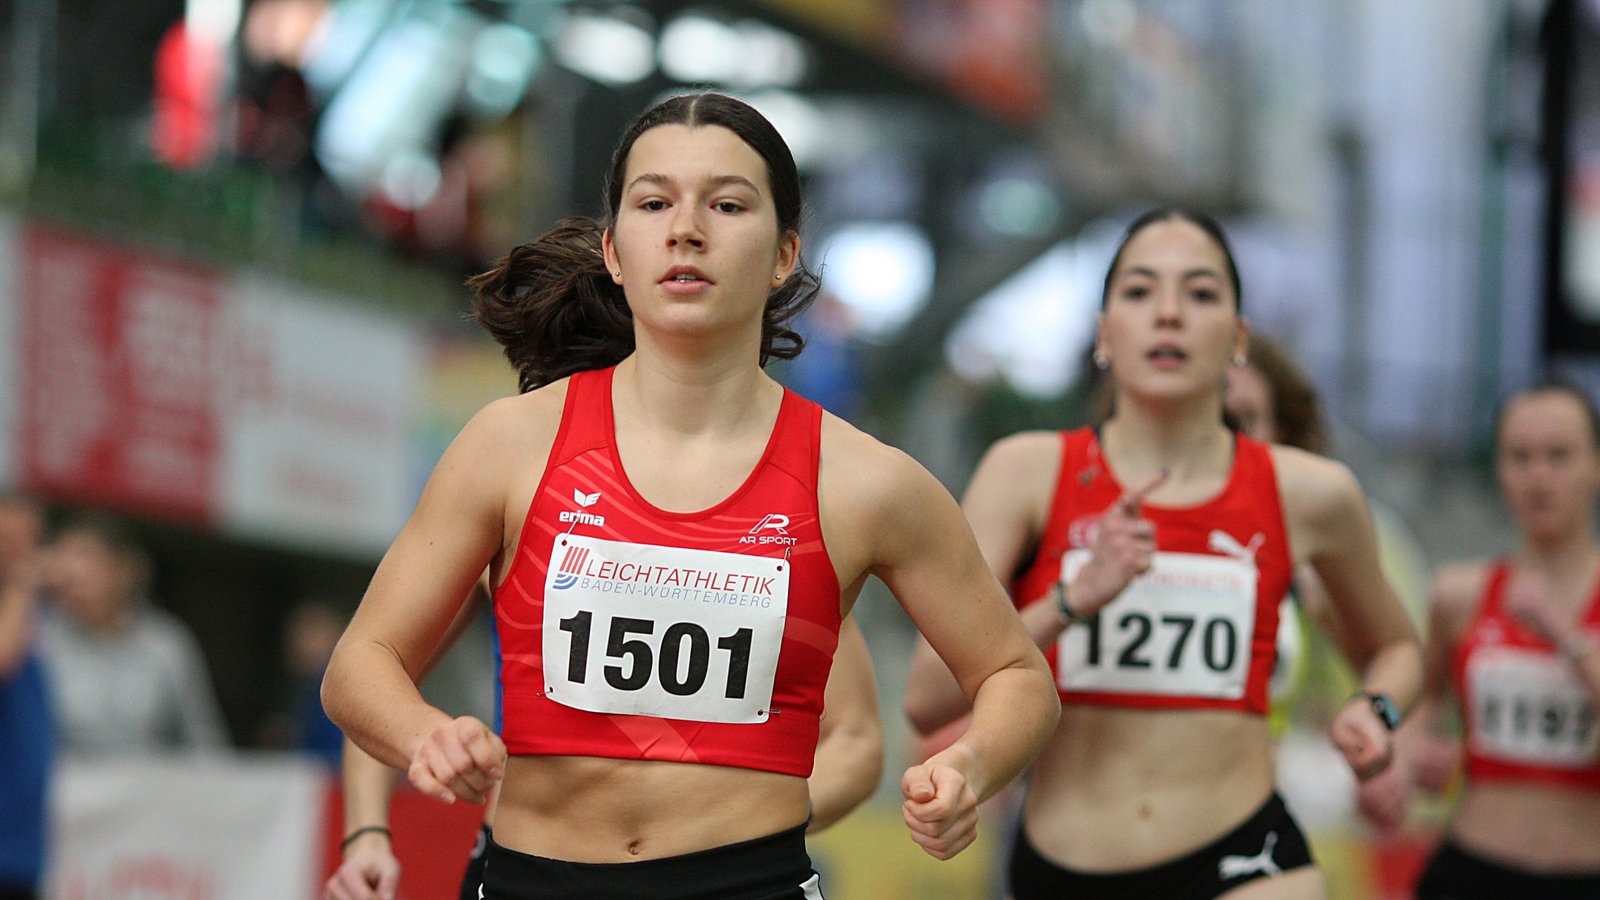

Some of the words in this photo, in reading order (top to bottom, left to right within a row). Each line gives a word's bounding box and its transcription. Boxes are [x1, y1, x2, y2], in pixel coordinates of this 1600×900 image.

[559, 510, 605, 527] erima
[739, 536, 756, 544] AR
[759, 536, 798, 546] SPORT
[580, 577, 771, 609] BADEN-WÜRTTEMBERG
[586, 559, 776, 596] LEICHTATHLETIK
[559, 609, 753, 699] 1501
[1079, 611, 1237, 673] 1270
